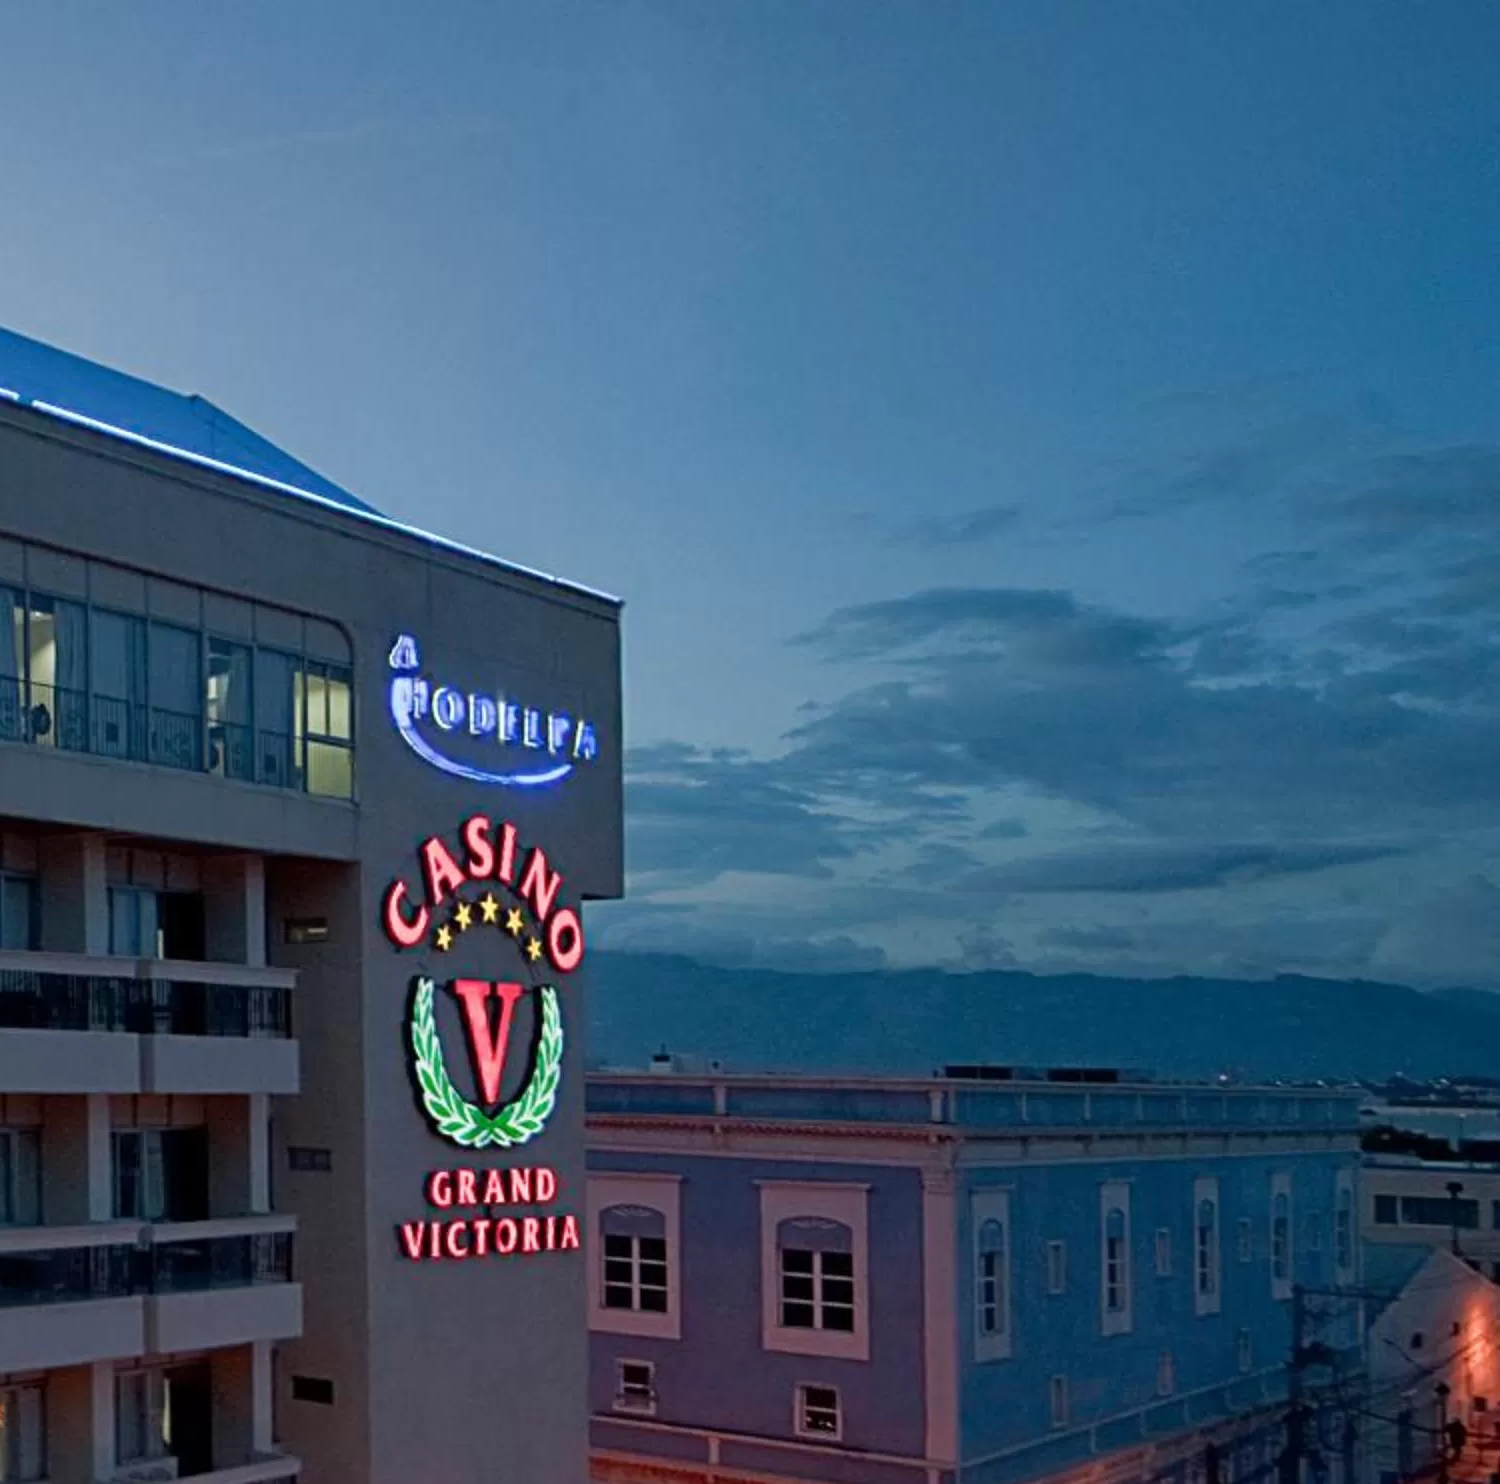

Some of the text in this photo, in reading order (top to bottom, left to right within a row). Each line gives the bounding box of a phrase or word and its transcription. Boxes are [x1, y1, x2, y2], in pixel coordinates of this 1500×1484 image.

[386, 814, 583, 971] CASINO
[455, 979, 523, 1104] V
[431, 1167, 556, 1206] GRAND
[402, 1216, 580, 1259] VICTORIA
